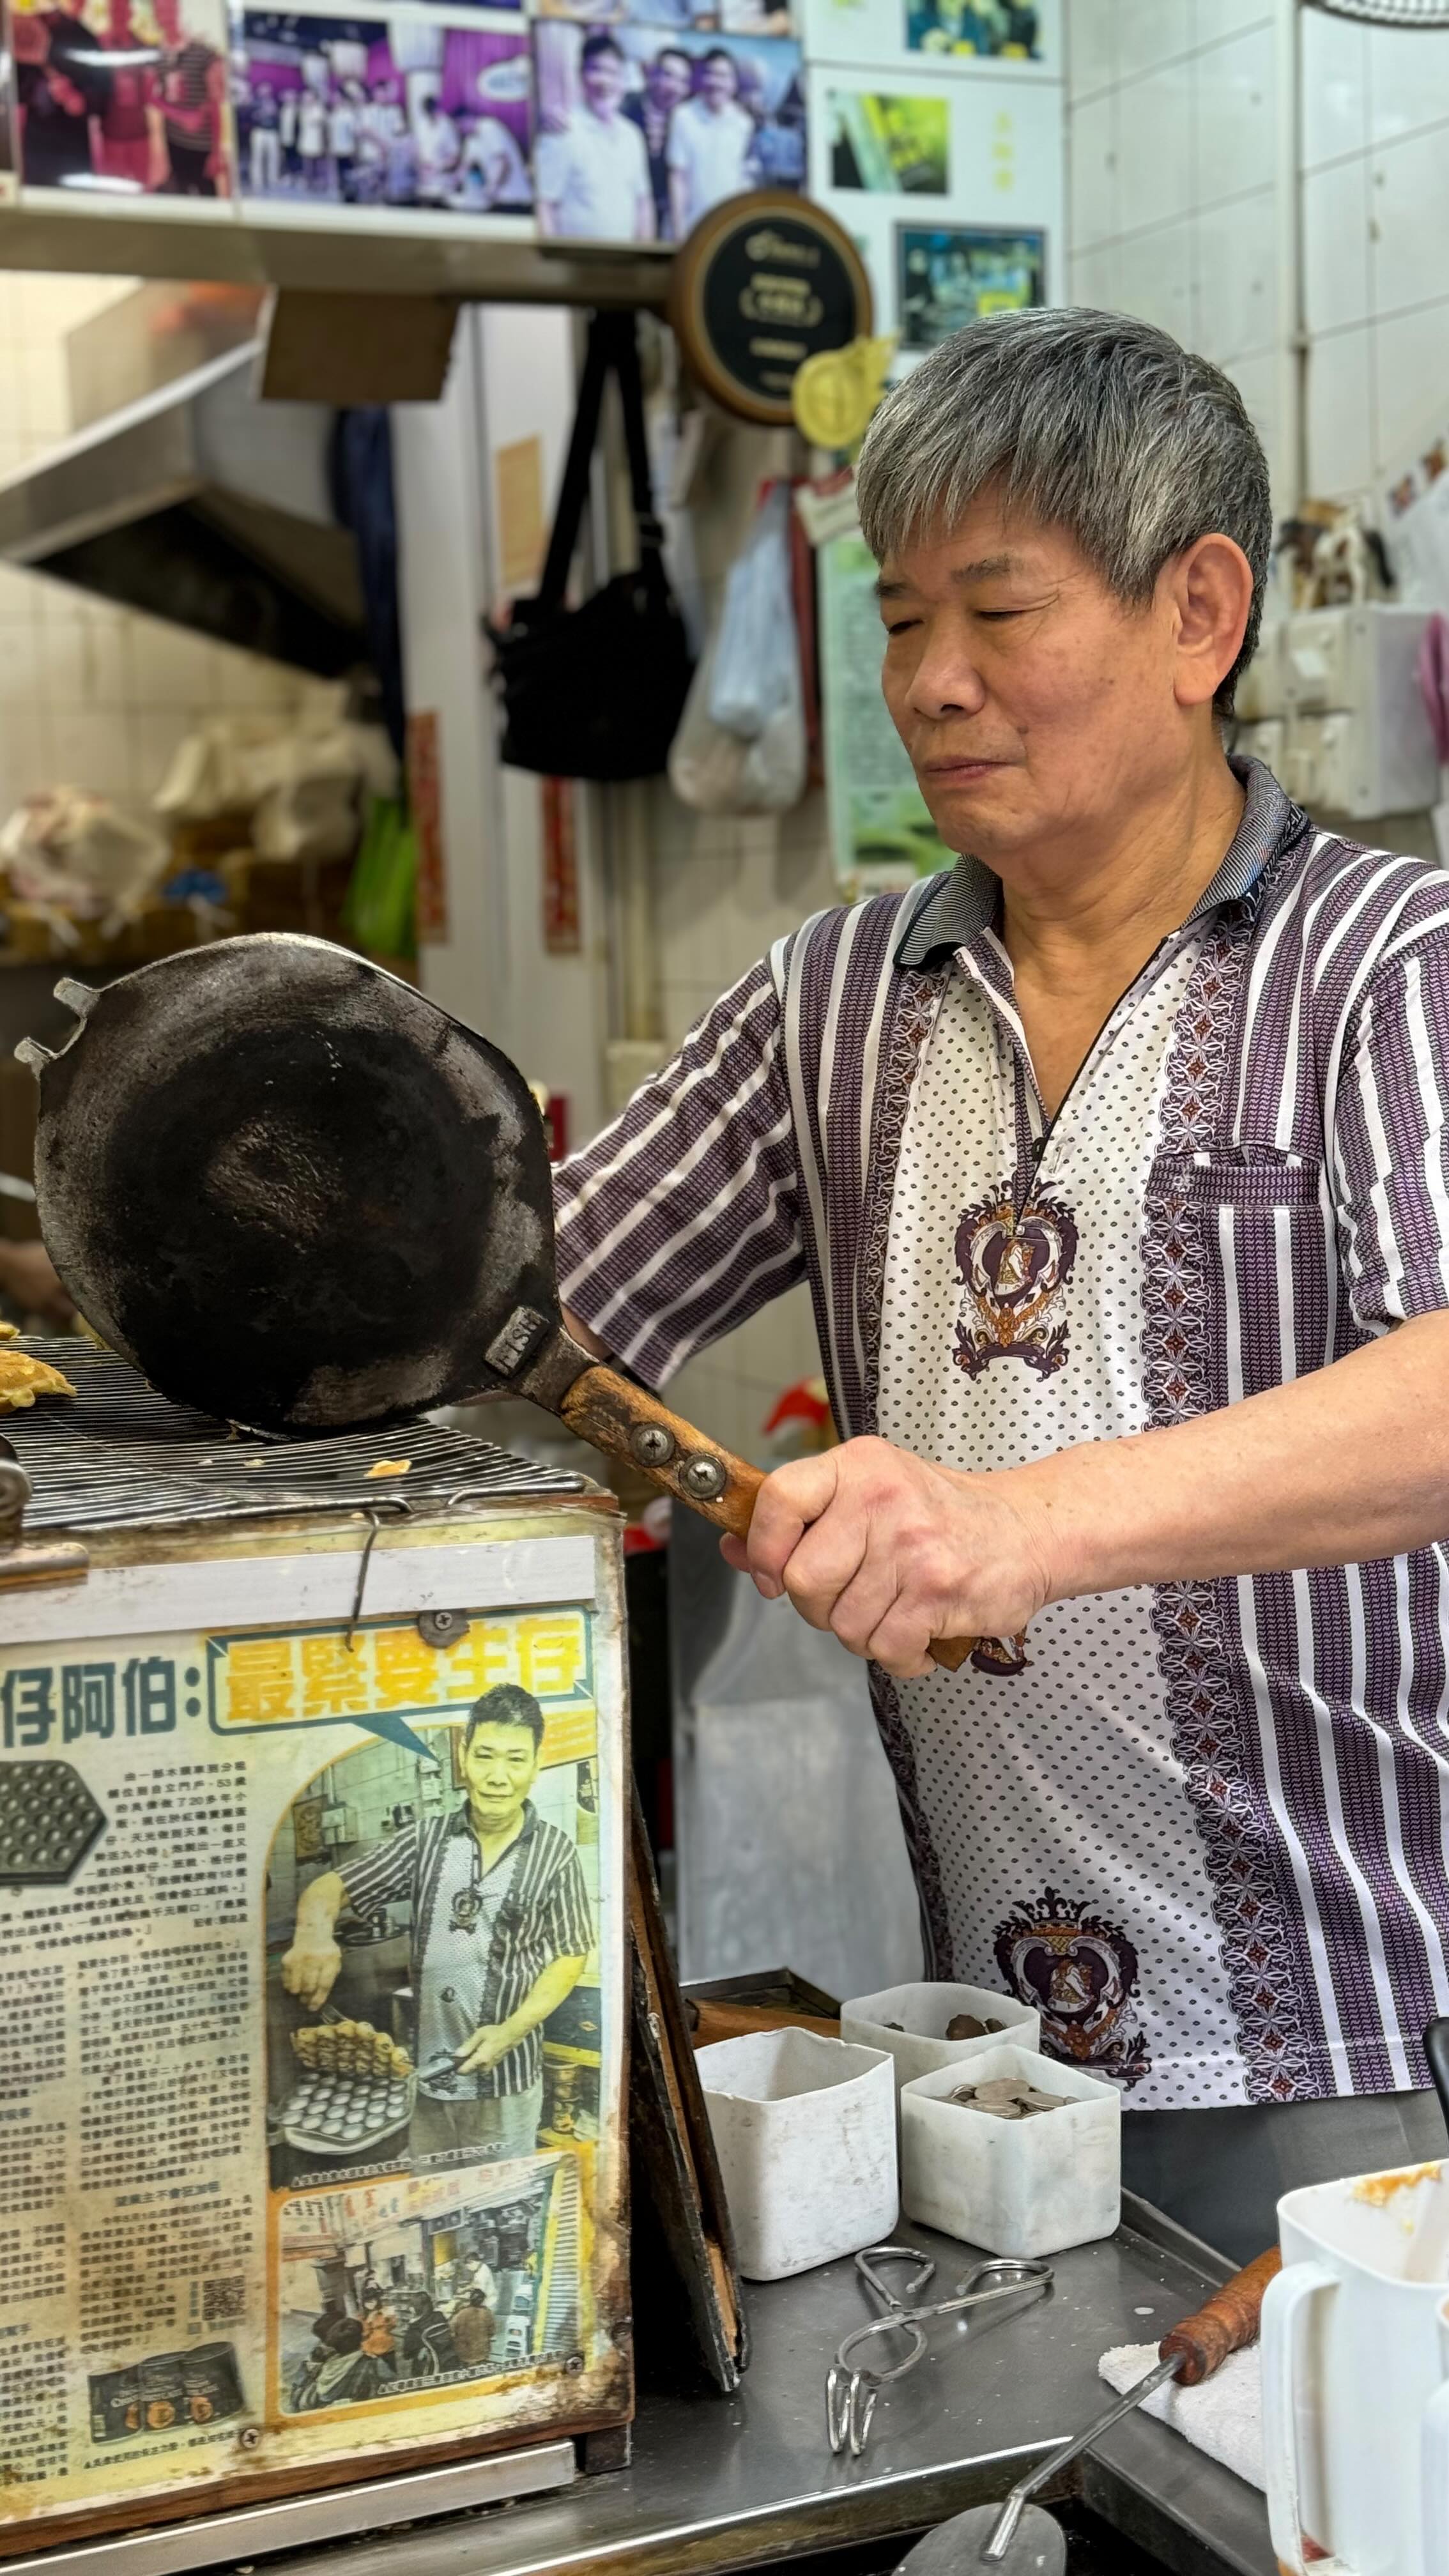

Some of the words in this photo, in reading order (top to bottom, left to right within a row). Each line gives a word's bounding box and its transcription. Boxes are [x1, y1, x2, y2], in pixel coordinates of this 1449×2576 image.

[225, 1616, 581, 1721] 最緊要生存
